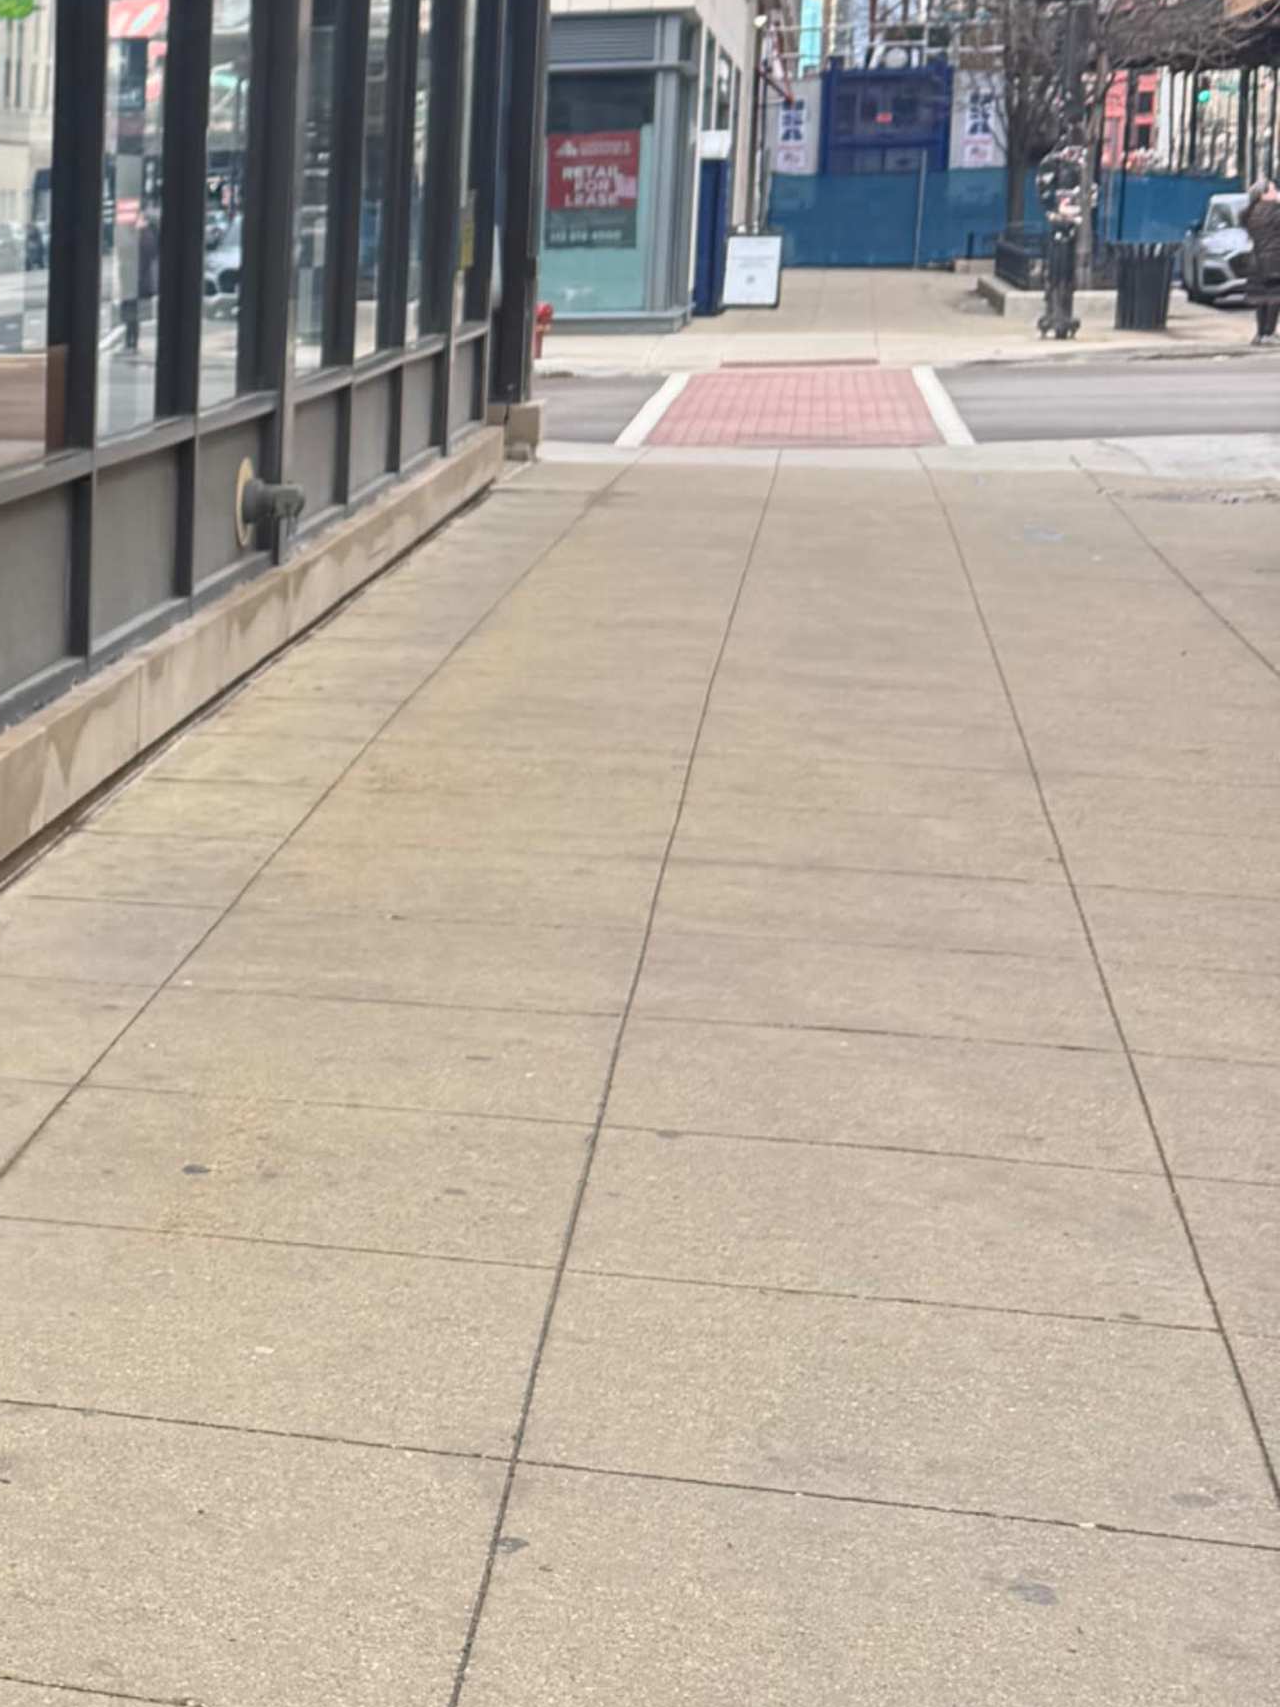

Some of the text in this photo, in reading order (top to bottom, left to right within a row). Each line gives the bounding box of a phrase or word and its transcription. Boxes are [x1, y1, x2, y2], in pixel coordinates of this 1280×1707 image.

[562, 164, 618, 179] RETAIL
[574, 179, 611, 193] FOR
[565, 193, 618, 208] LEASE
